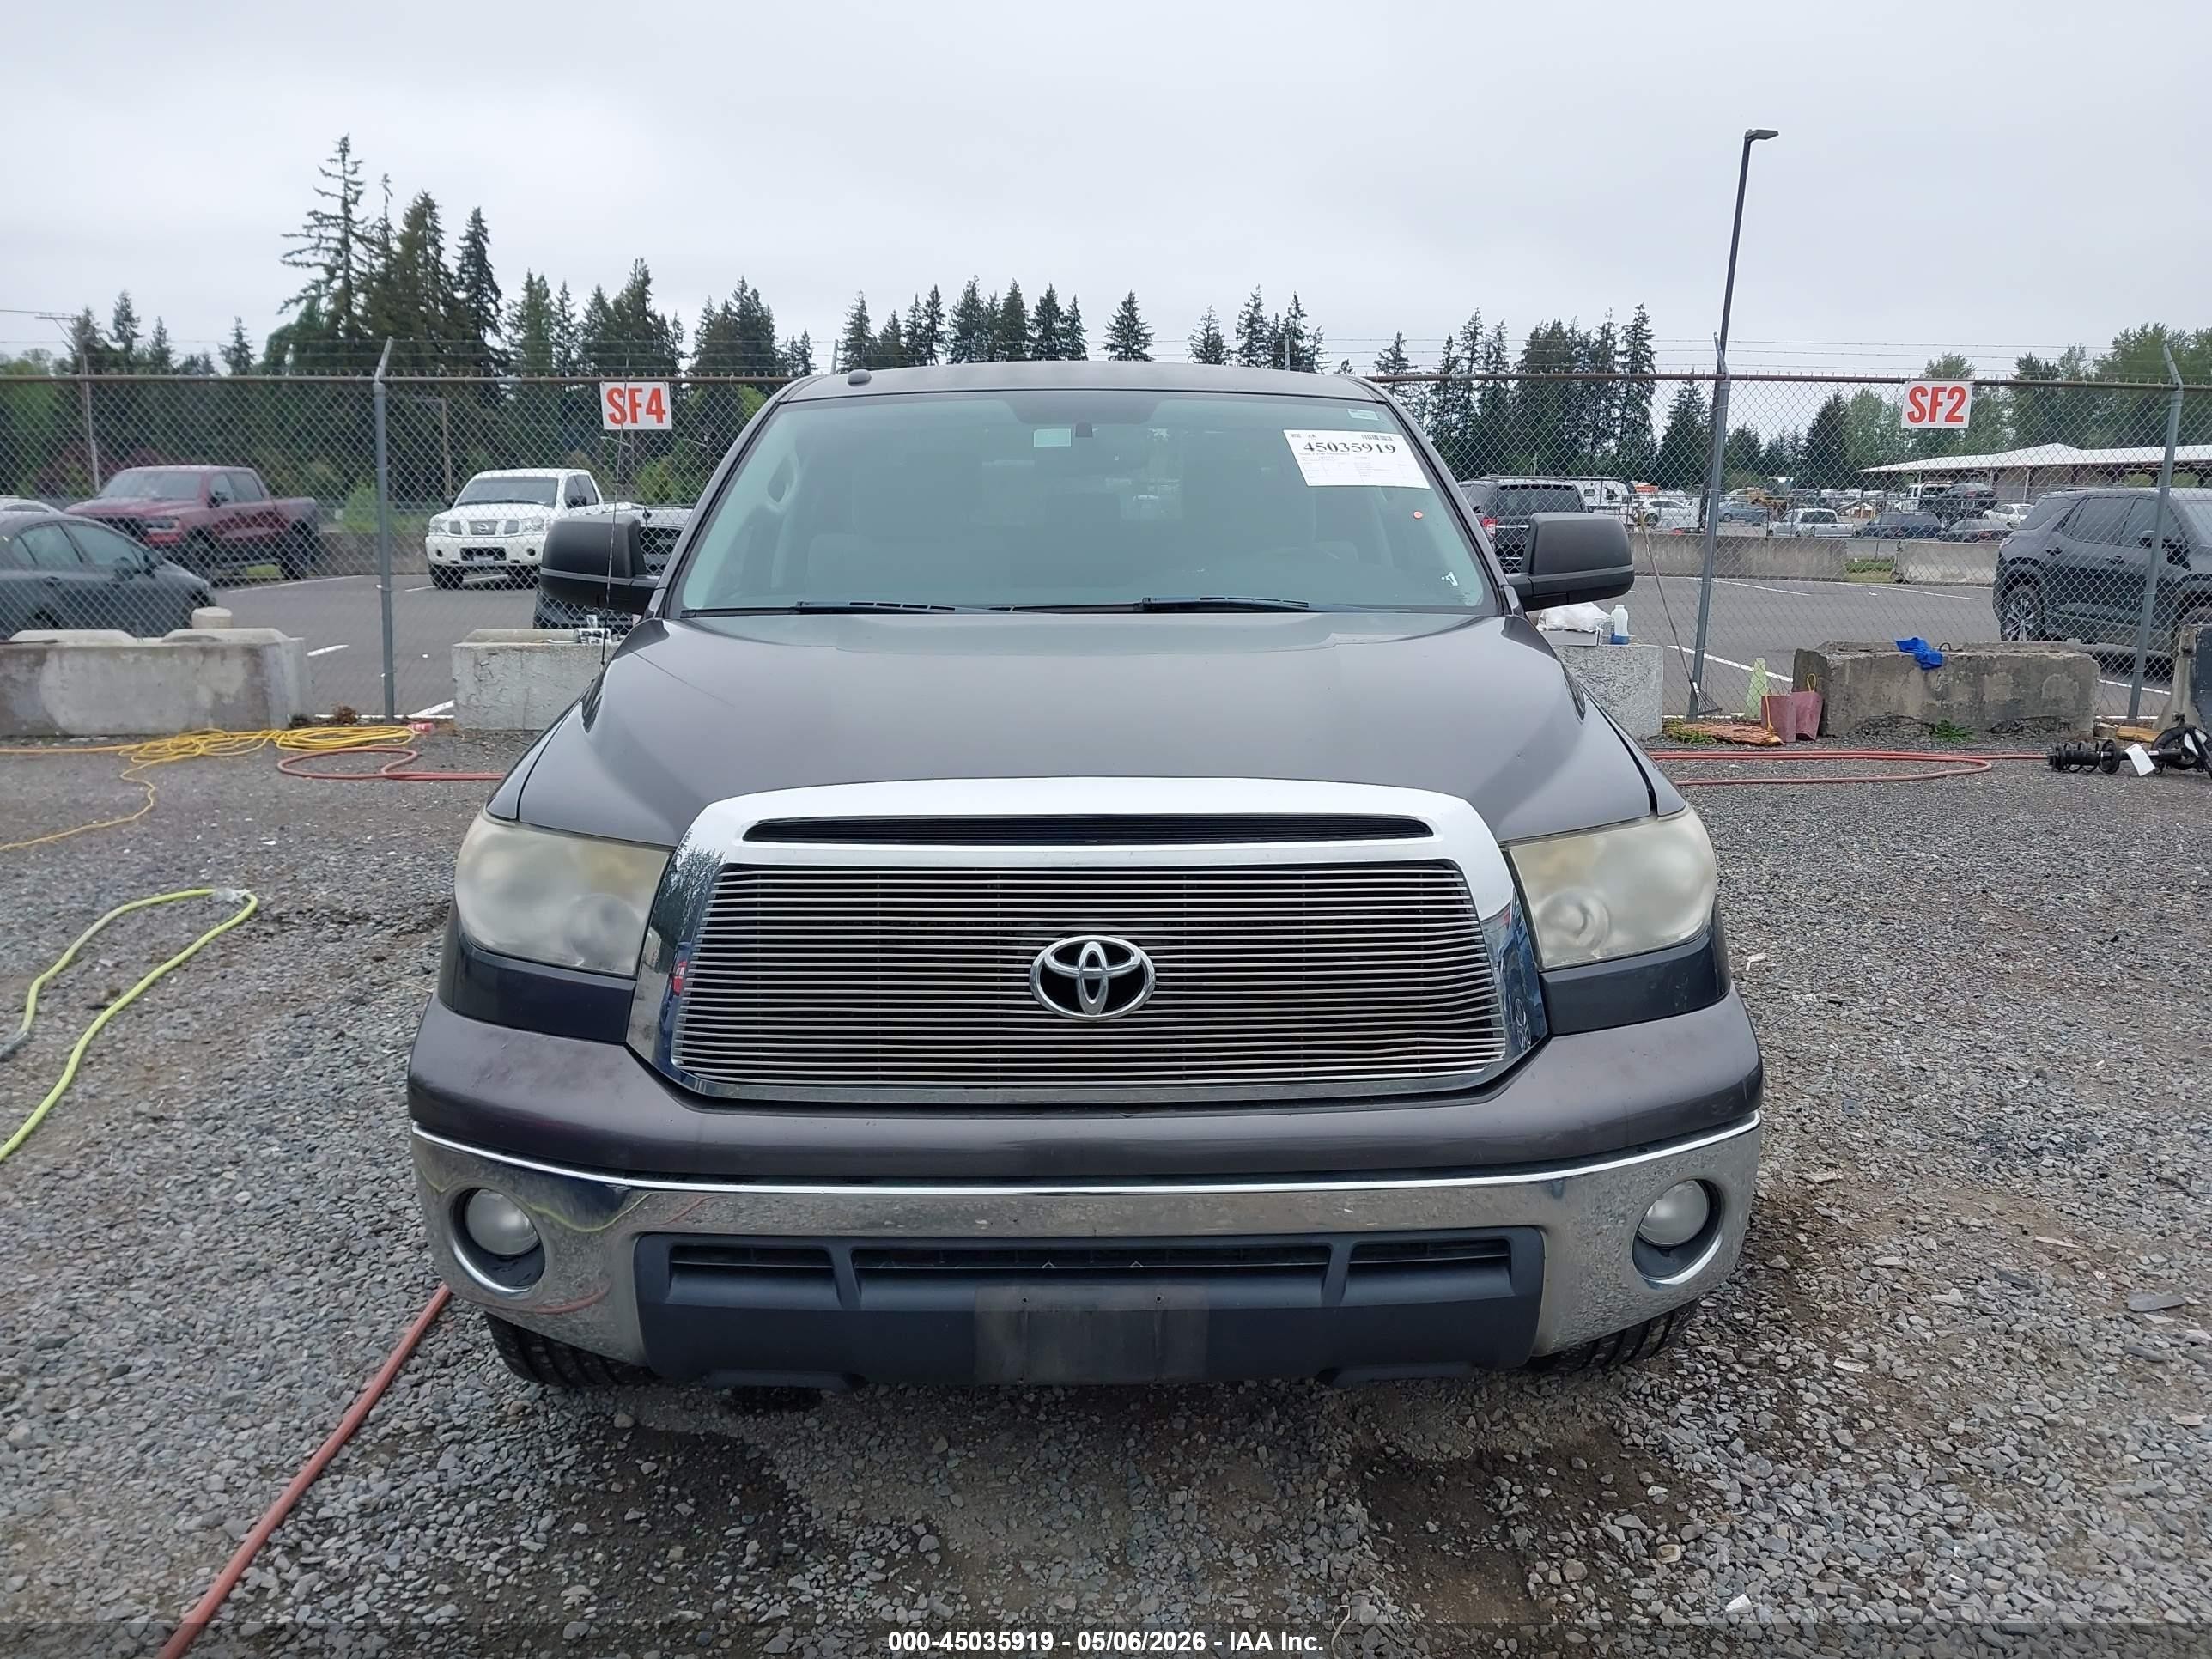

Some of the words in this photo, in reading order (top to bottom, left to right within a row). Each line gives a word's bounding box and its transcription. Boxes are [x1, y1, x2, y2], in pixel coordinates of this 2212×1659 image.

[606, 387, 666, 425] SF4
[1907, 386, 1966, 423] SF2
[1303, 441, 1397, 454] 45035919
